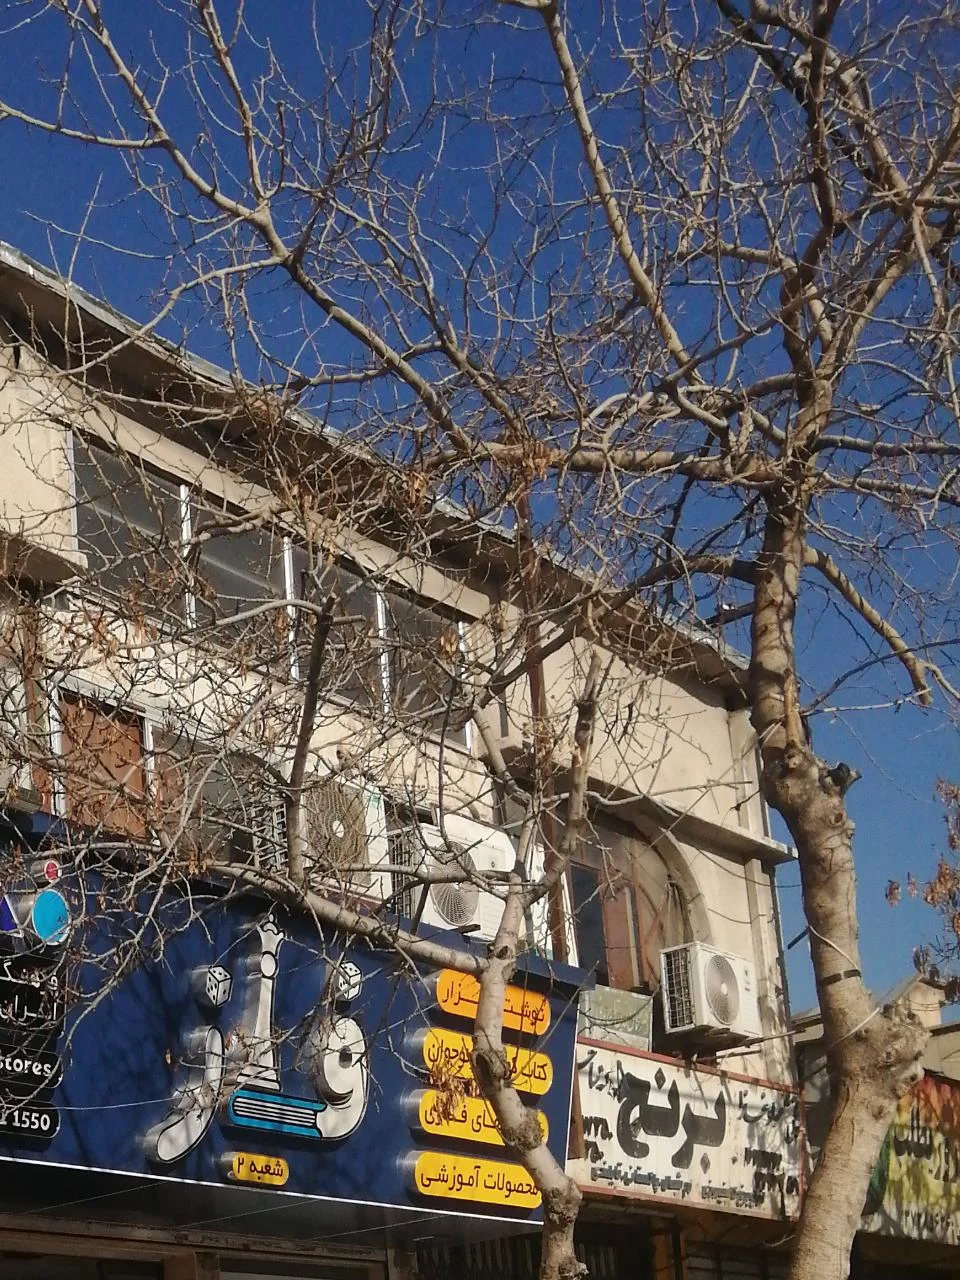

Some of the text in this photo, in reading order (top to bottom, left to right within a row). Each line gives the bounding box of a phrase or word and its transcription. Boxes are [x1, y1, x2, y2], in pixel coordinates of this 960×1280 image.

[12, 1109, 51, 1132] 1550
[617, 1067, 726, 1175] برنج
[249, 1160, 284, 1181] شعبه
[420, 1164, 539, 1199] محصولات آموزشی
